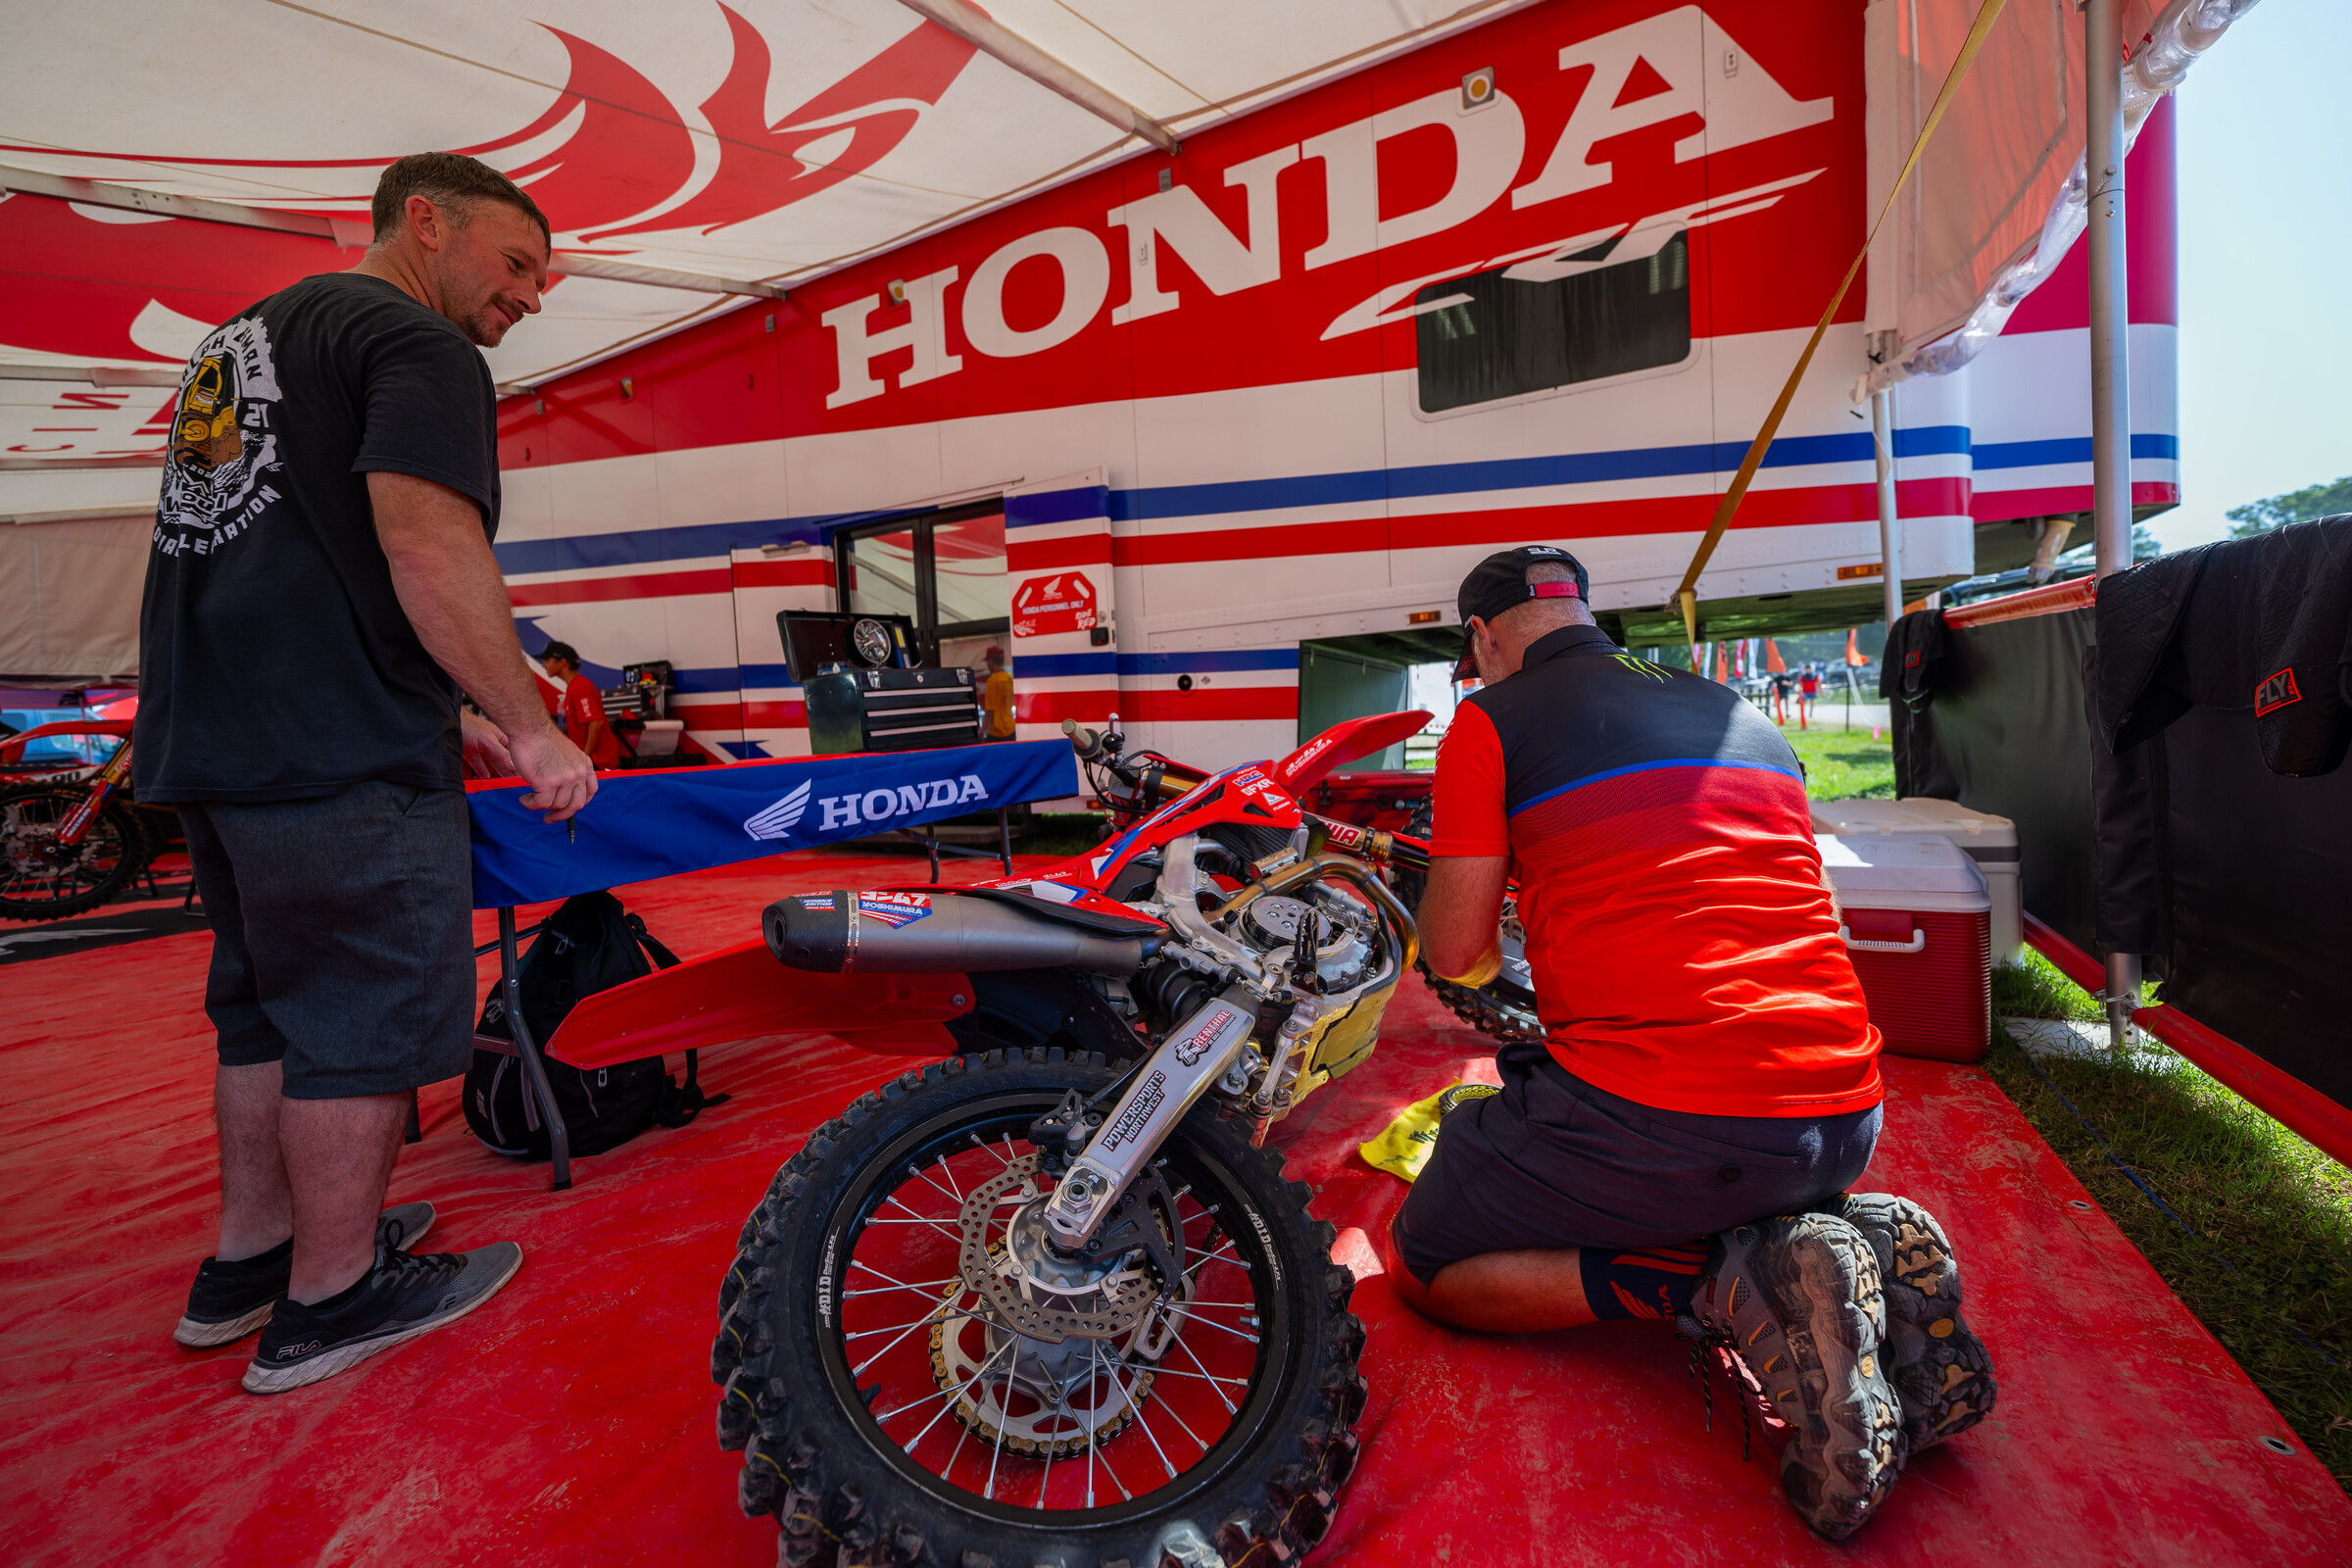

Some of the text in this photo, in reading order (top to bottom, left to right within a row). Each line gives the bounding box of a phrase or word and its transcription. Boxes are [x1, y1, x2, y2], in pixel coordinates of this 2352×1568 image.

[821, 5, 1835, 410] HONDA
[1022, 606, 1040, 614] HONDA
[1077, 616, 1096, 629] RED
[2257, 672, 2287, 710] FLY
[818, 774, 989, 831] HONDA
[862, 901, 923, 915] YOSHIMURA
[1192, 1010, 1231, 1049] RENTHAL
[1102, 1071, 1165, 1151] POWERSPORTS
[1125, 1089, 1164, 1143] NORTHWEST
[276, 1340, 321, 1360] FILA
